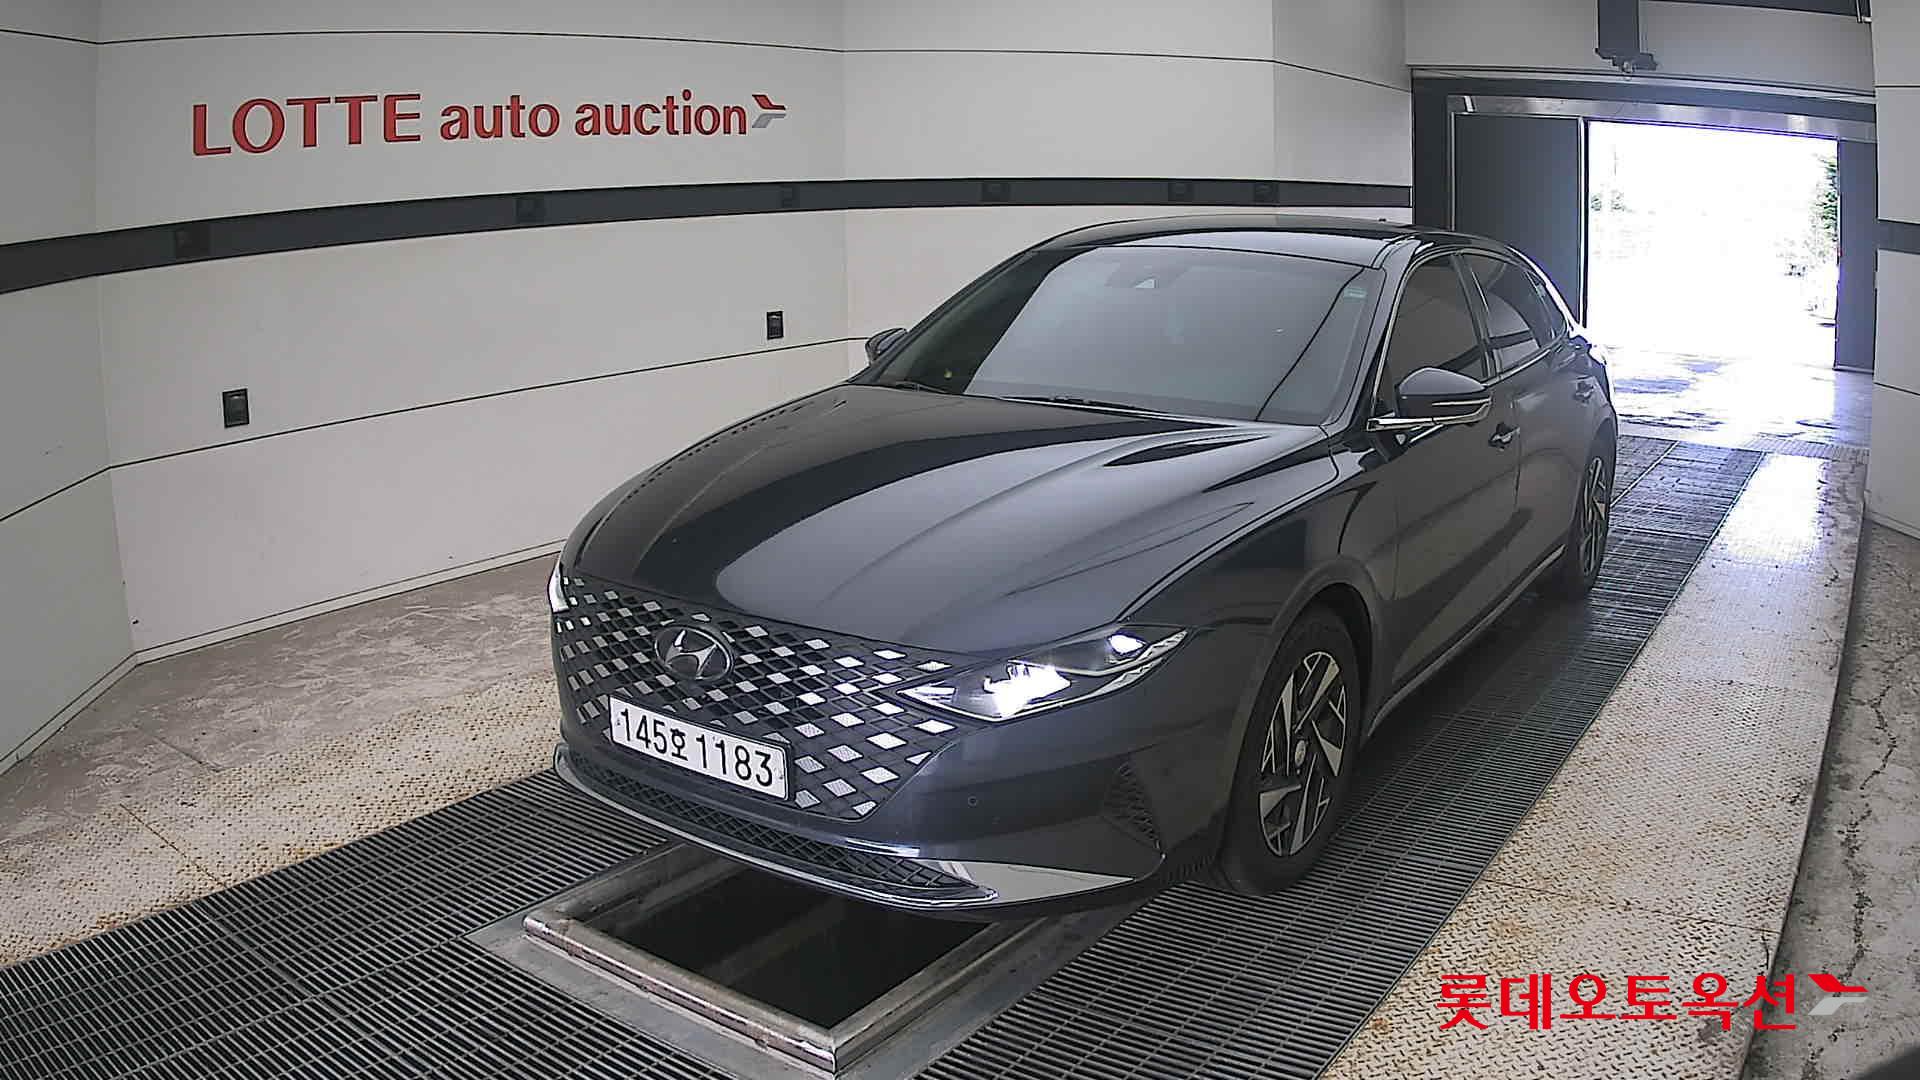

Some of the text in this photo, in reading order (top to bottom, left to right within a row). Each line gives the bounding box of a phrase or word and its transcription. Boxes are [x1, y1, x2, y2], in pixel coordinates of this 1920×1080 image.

[192, 89, 747, 156] LOTTE auto auction
[696, 733, 773, 787] 1183
